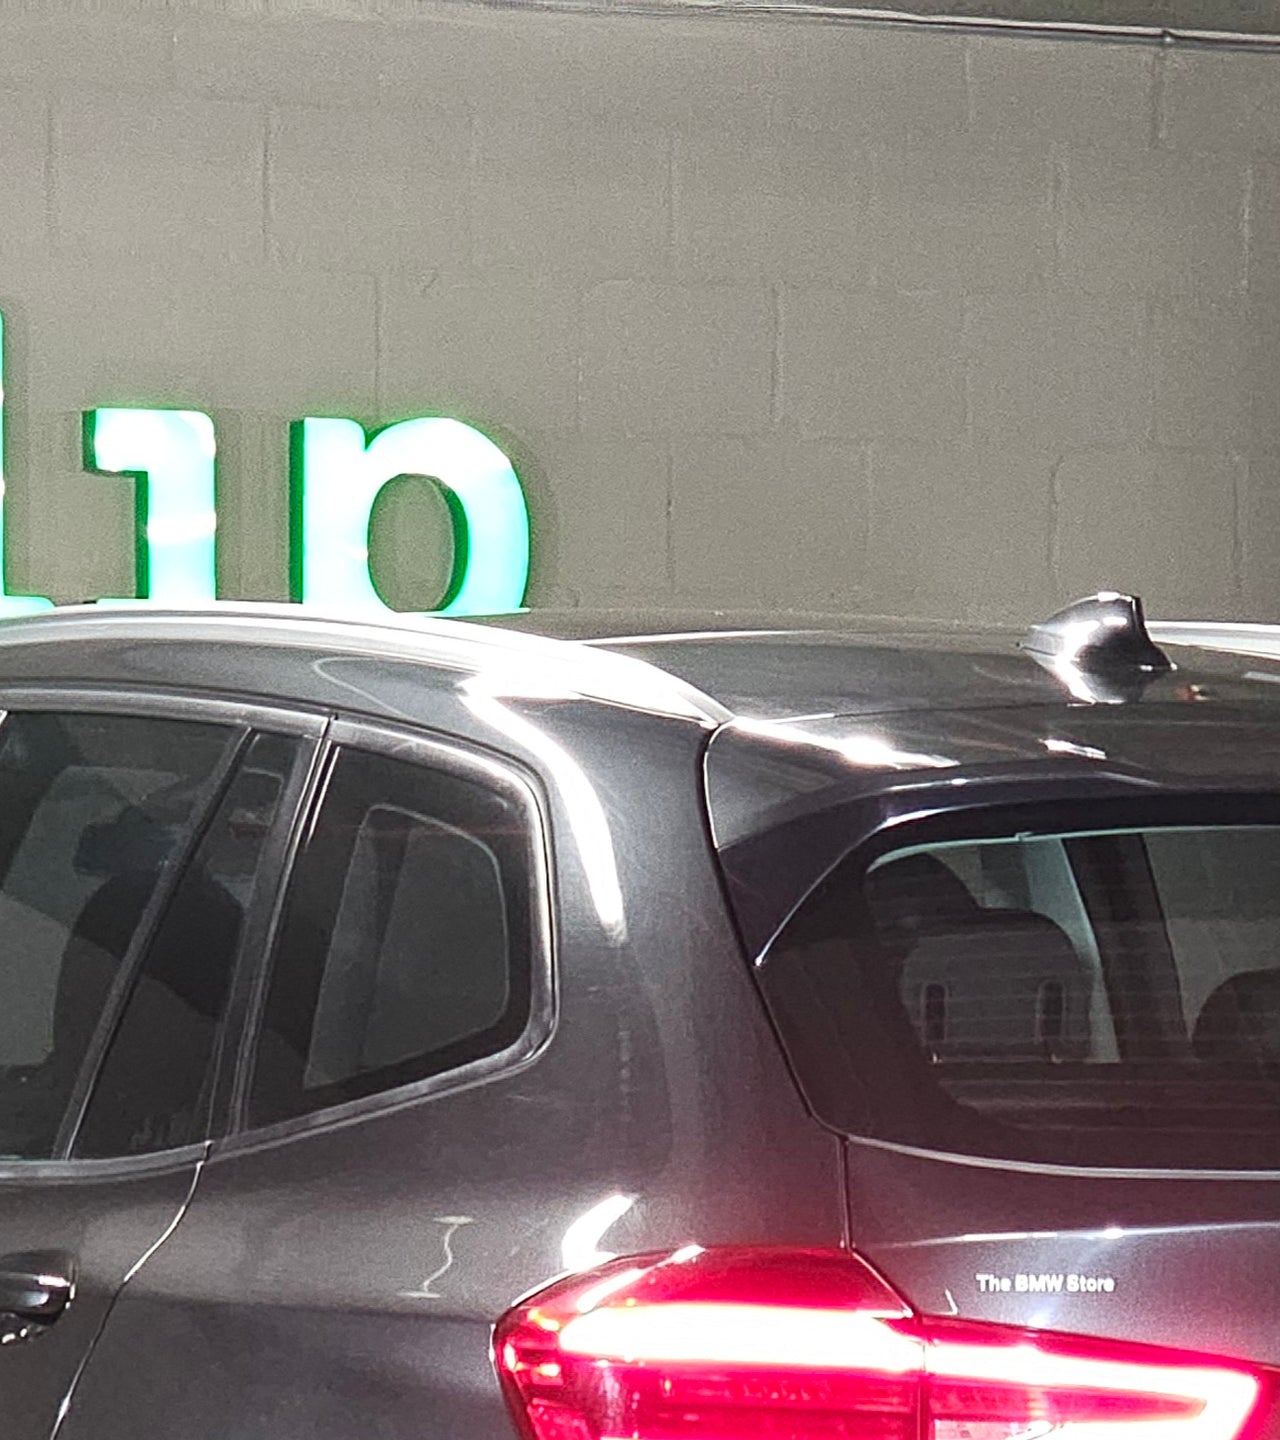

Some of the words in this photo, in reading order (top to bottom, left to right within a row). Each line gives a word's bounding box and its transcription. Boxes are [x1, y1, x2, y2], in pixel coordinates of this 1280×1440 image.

[976, 1273, 1011, 1292] The
[1014, 1274, 1064, 1292] BMW
[1066, 1274, 1116, 1292] Store
